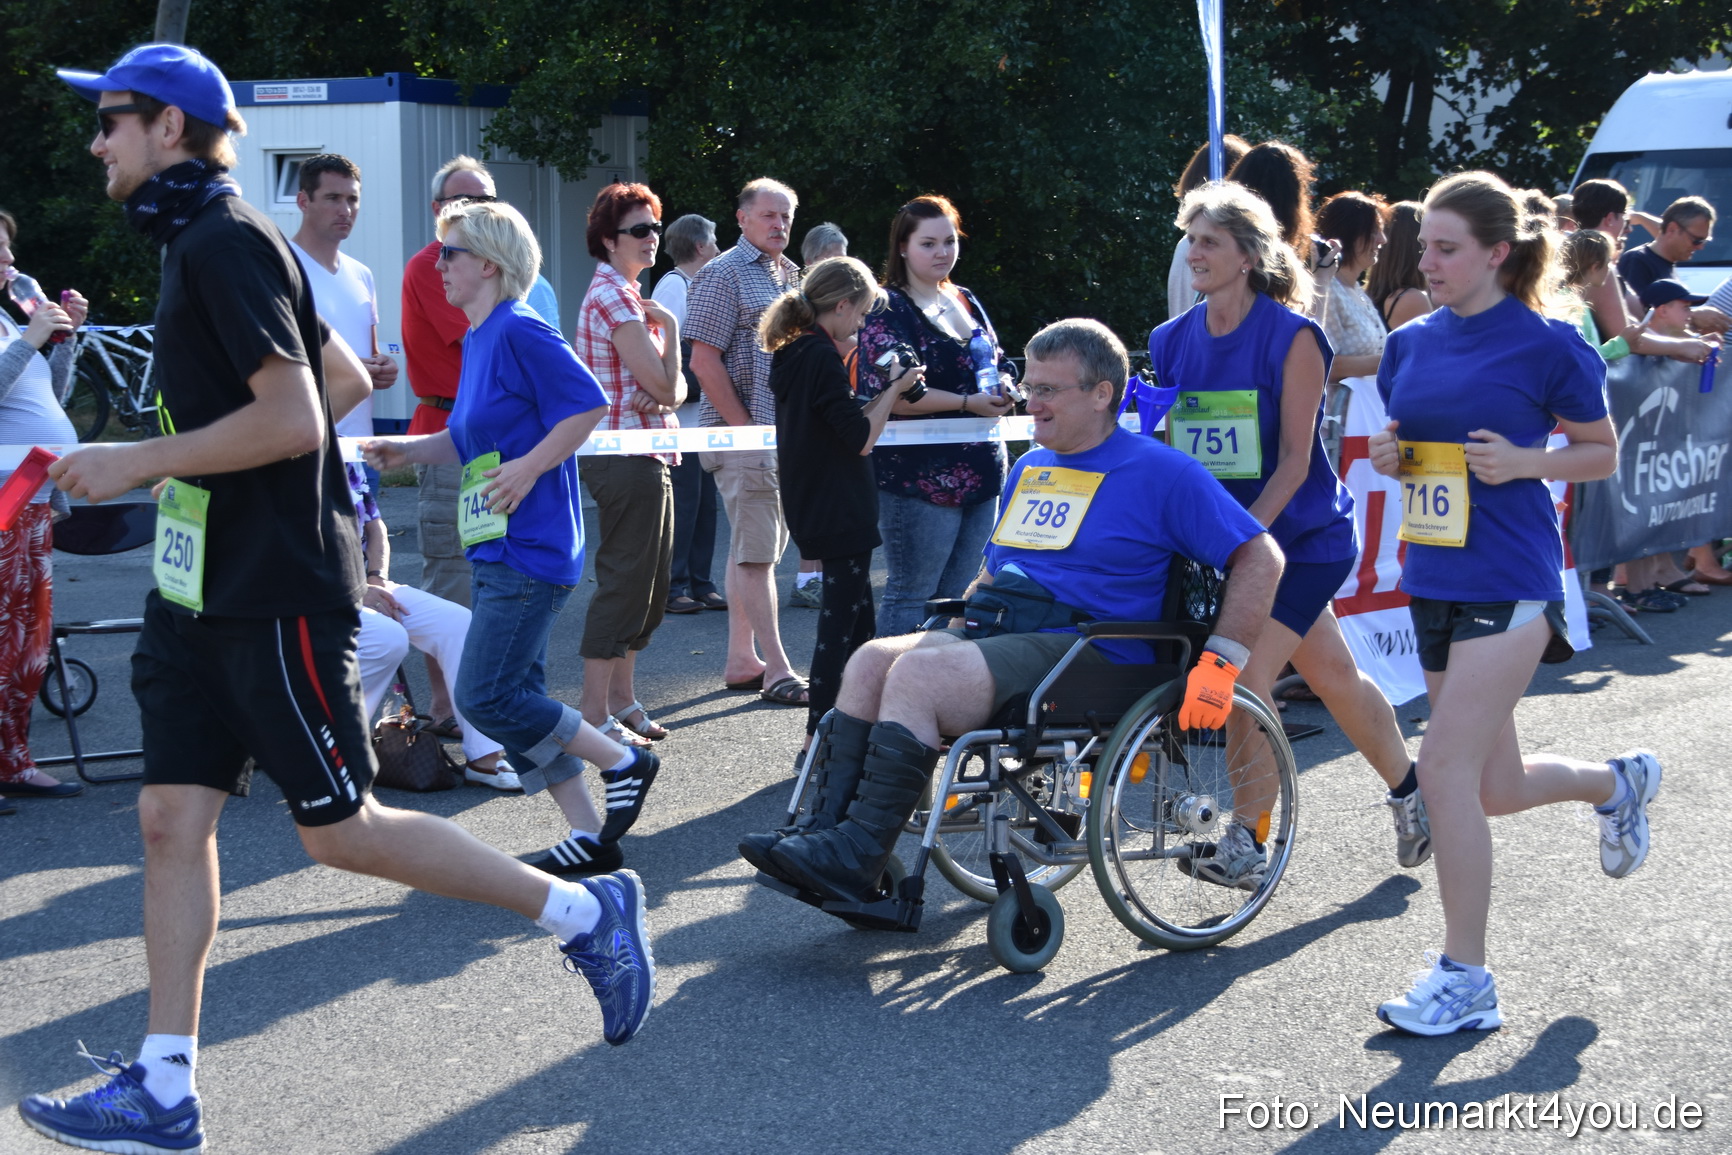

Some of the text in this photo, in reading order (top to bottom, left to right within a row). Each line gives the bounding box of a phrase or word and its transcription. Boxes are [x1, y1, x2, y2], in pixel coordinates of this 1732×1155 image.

[1186, 426, 1238, 455] 751
[1634, 433, 1730, 496] Fischer
[463, 492, 492, 523] 744
[1021, 499, 1071, 529] 798
[1405, 482, 1450, 517] 716
[1648, 492, 1718, 528] AUTOMOBILE
[1033, 531, 1058, 540] Obermeier
[1425, 522, 1449, 532] Schreyer
[161, 527, 194, 573] 250
